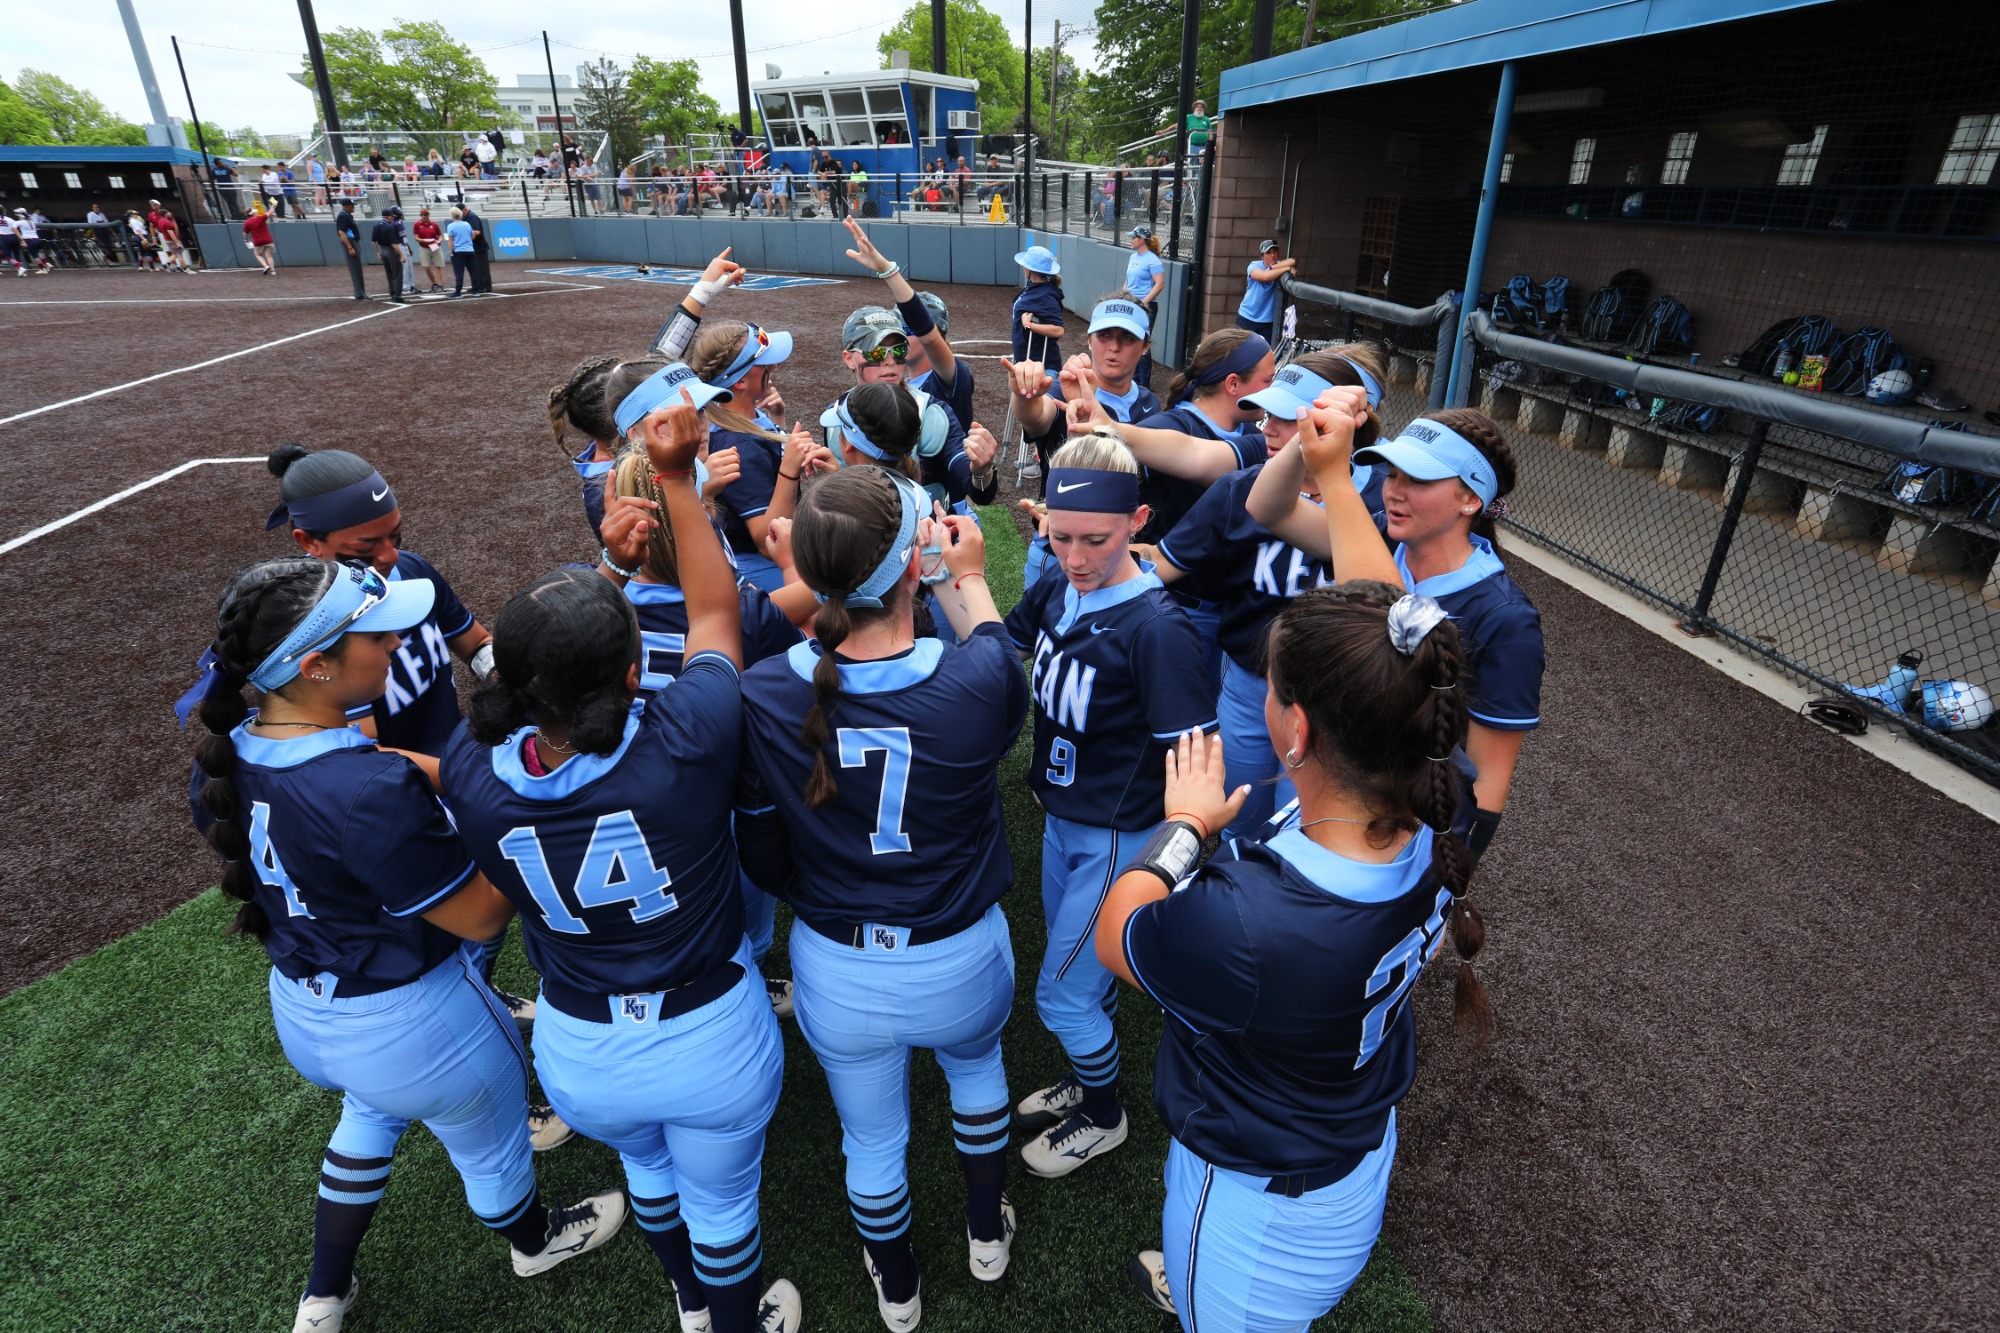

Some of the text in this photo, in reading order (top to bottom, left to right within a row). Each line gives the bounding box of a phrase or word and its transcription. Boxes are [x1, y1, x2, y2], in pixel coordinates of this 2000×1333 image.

[498, 237, 529, 247] NCAA
[1105, 304, 1134, 316] KEAN
[1046, 736, 1077, 787] 9
[836, 727, 912, 855] 7
[249, 800, 317, 919] 4
[497, 809, 680, 935] 14
[872, 927, 898, 952] KU
[621, 995, 649, 1024] KU
